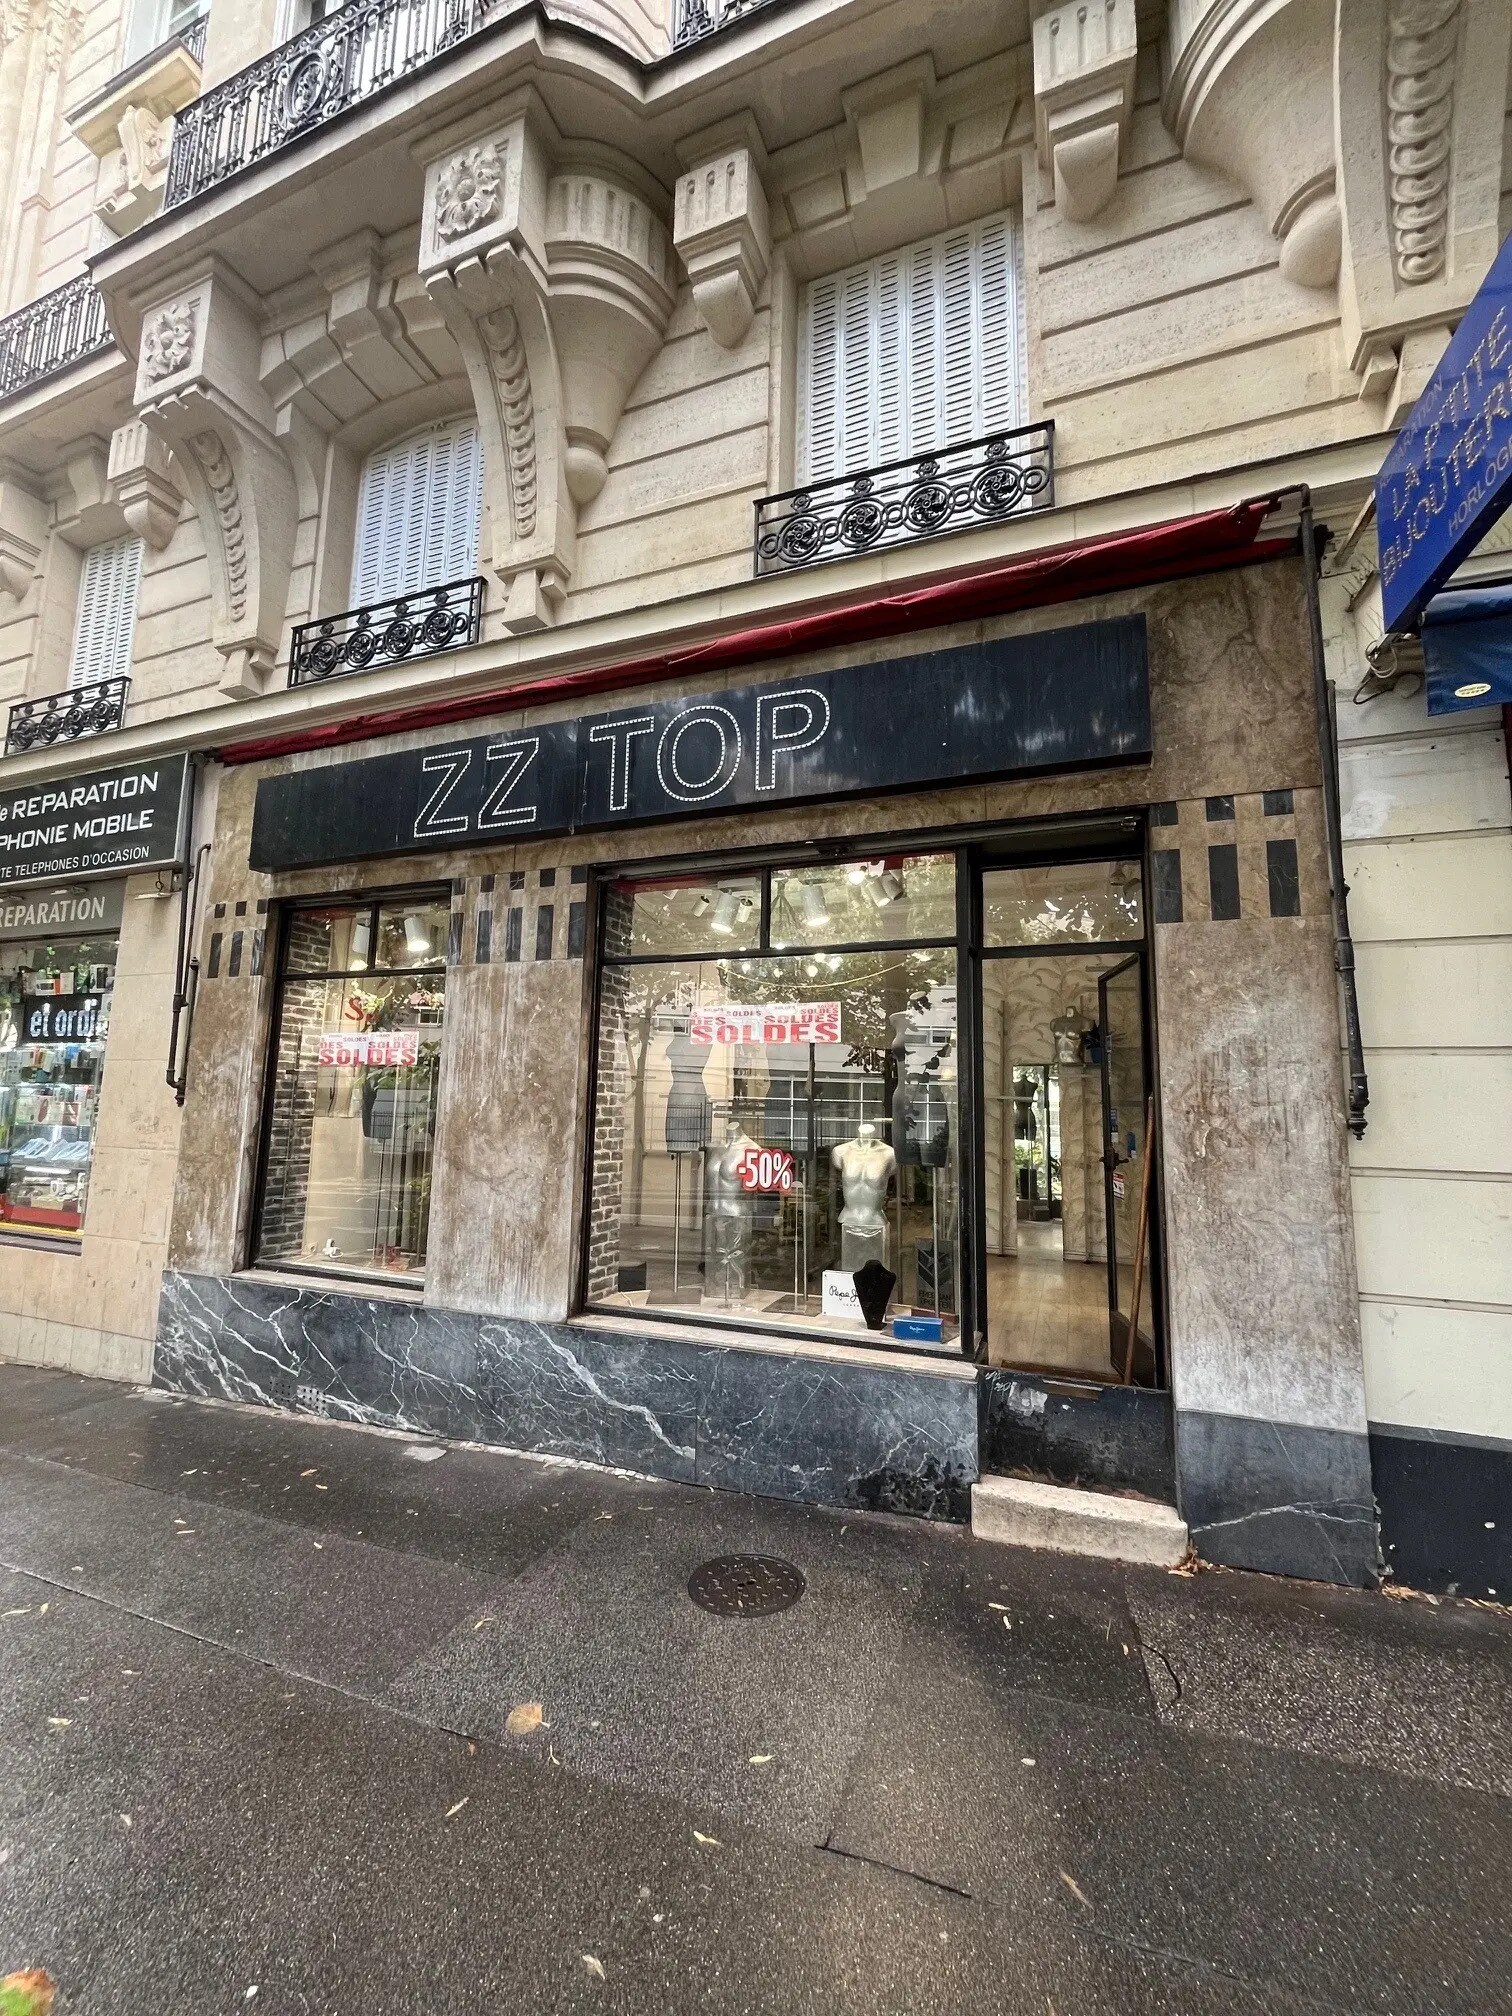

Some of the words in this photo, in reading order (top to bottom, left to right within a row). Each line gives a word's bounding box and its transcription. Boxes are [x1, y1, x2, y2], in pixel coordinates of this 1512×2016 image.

[414, 738, 539, 839] ZZ
[589, 689, 830, 812] TOP
[12, 771, 159, 820] REPARATION
[73, 809, 154, 840] MOBILE
[15, 857, 79, 876] TELEPHONES
[82, 846, 150, 867] D'OCCASION
[691, 1022, 839, 1045] SOLDES
[764, 1014, 839, 1024] SOLDES
[319, 1048, 416, 1067] SOLDES
[368, 1041, 417, 1049] SOLDES
[739, 1152, 791, 1190] -50%
